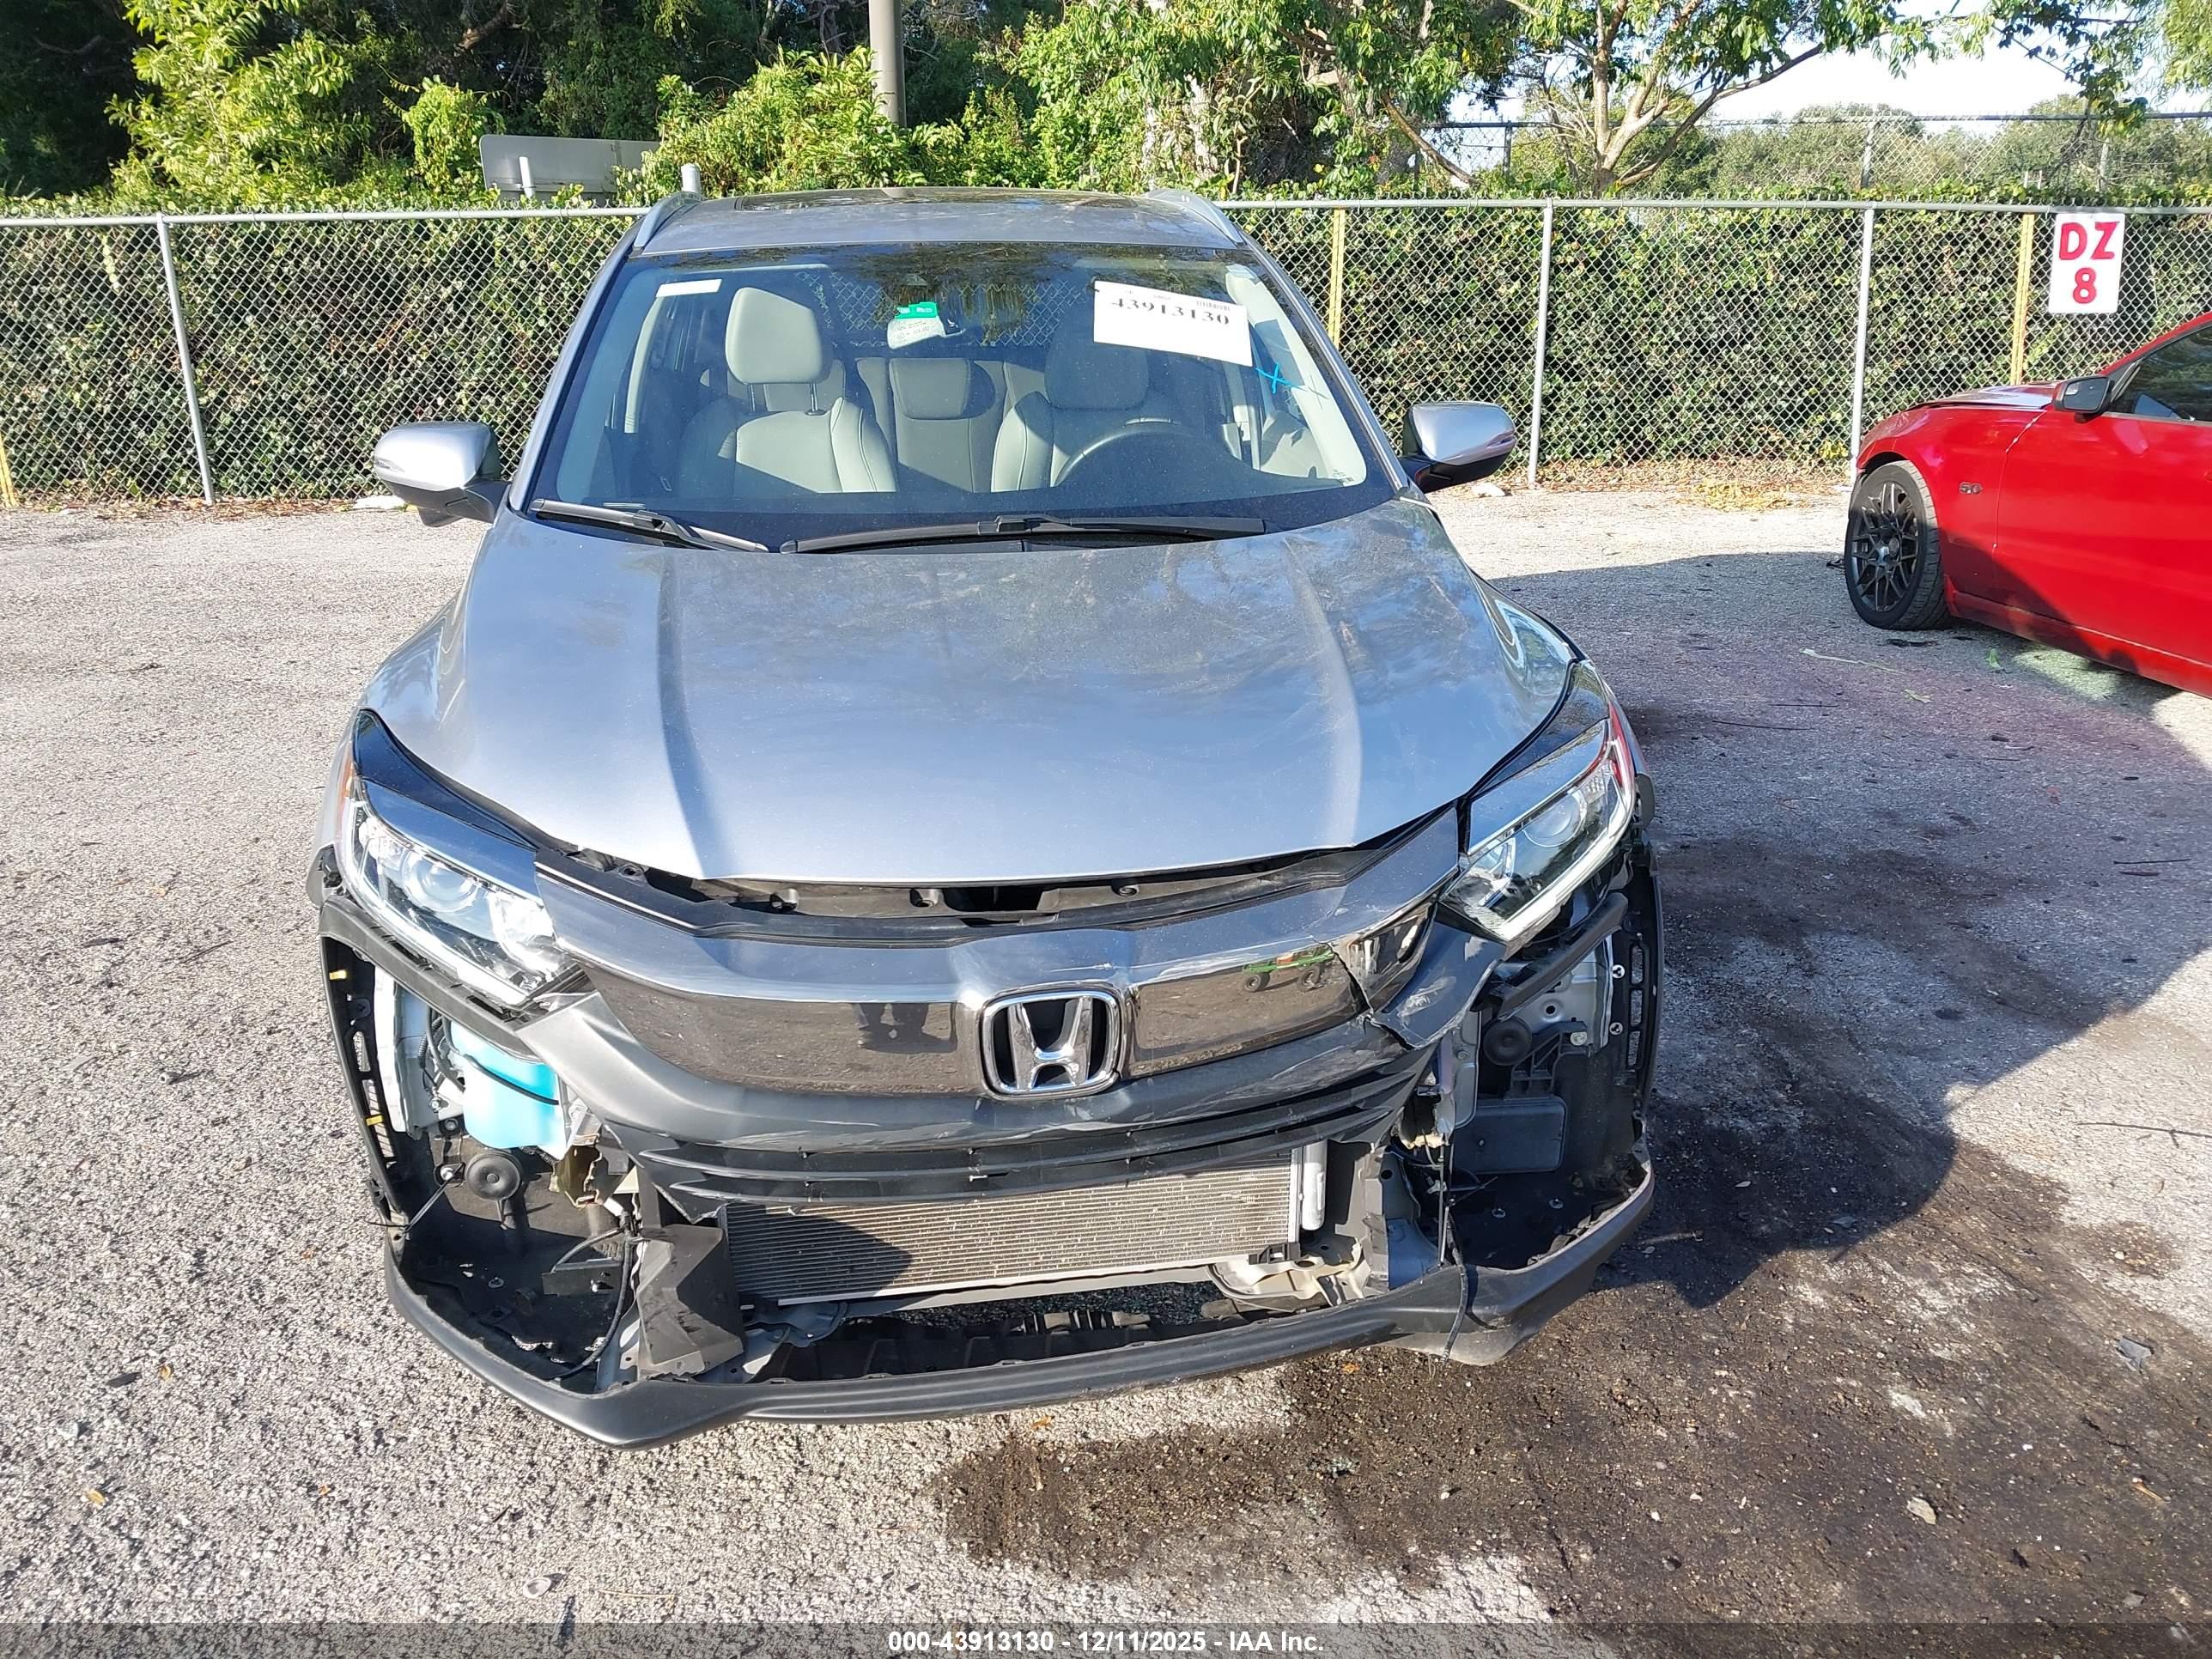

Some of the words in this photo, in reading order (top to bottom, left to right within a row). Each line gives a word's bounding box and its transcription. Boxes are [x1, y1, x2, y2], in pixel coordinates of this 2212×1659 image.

[2058, 221, 2120, 260] DZ
[2072, 267, 2097, 304] 8
[1111, 297, 1230, 325] 43913130
